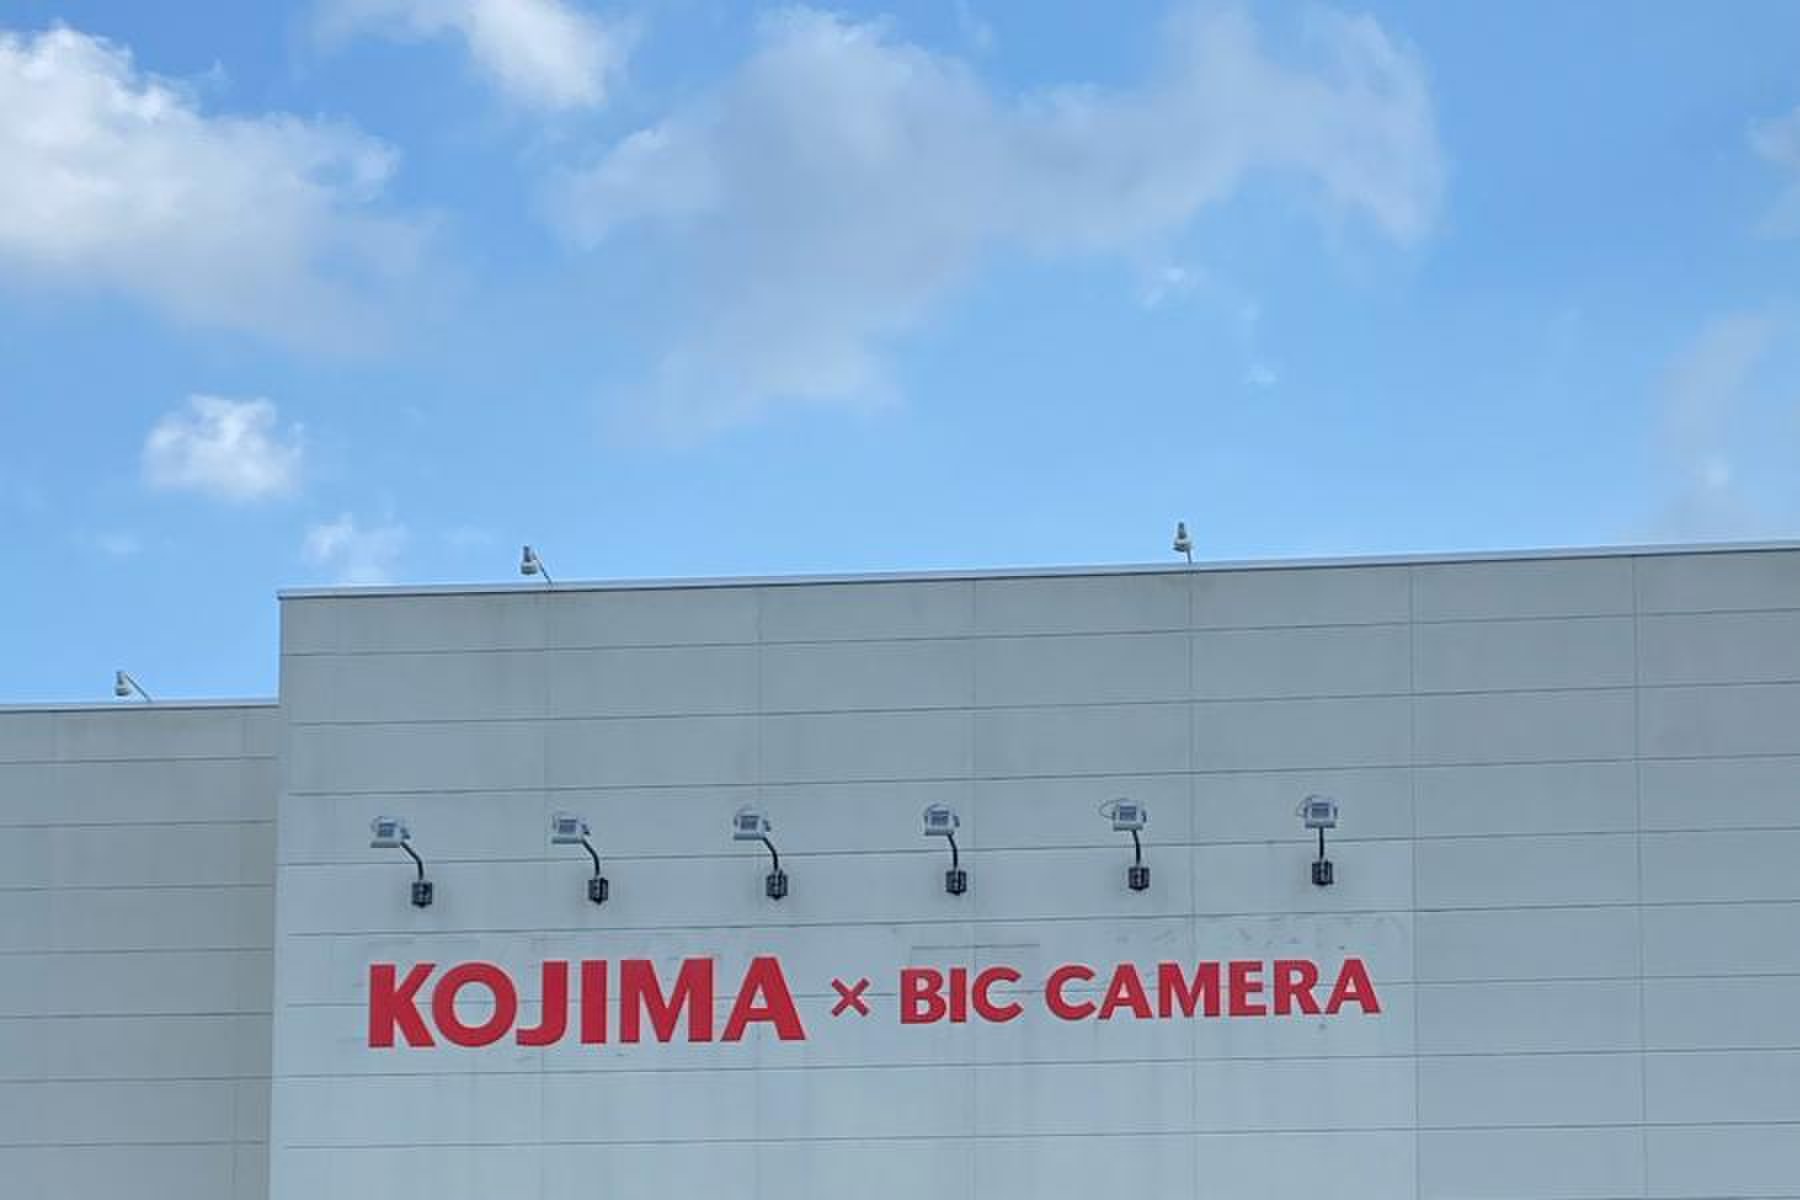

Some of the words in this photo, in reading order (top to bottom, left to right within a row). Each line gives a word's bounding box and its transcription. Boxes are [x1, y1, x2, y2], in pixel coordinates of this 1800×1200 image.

[368, 956, 806, 1048] KOJIMA
[900, 967, 1022, 1024] BIC
[1045, 958, 1381, 1021] CAMERA
